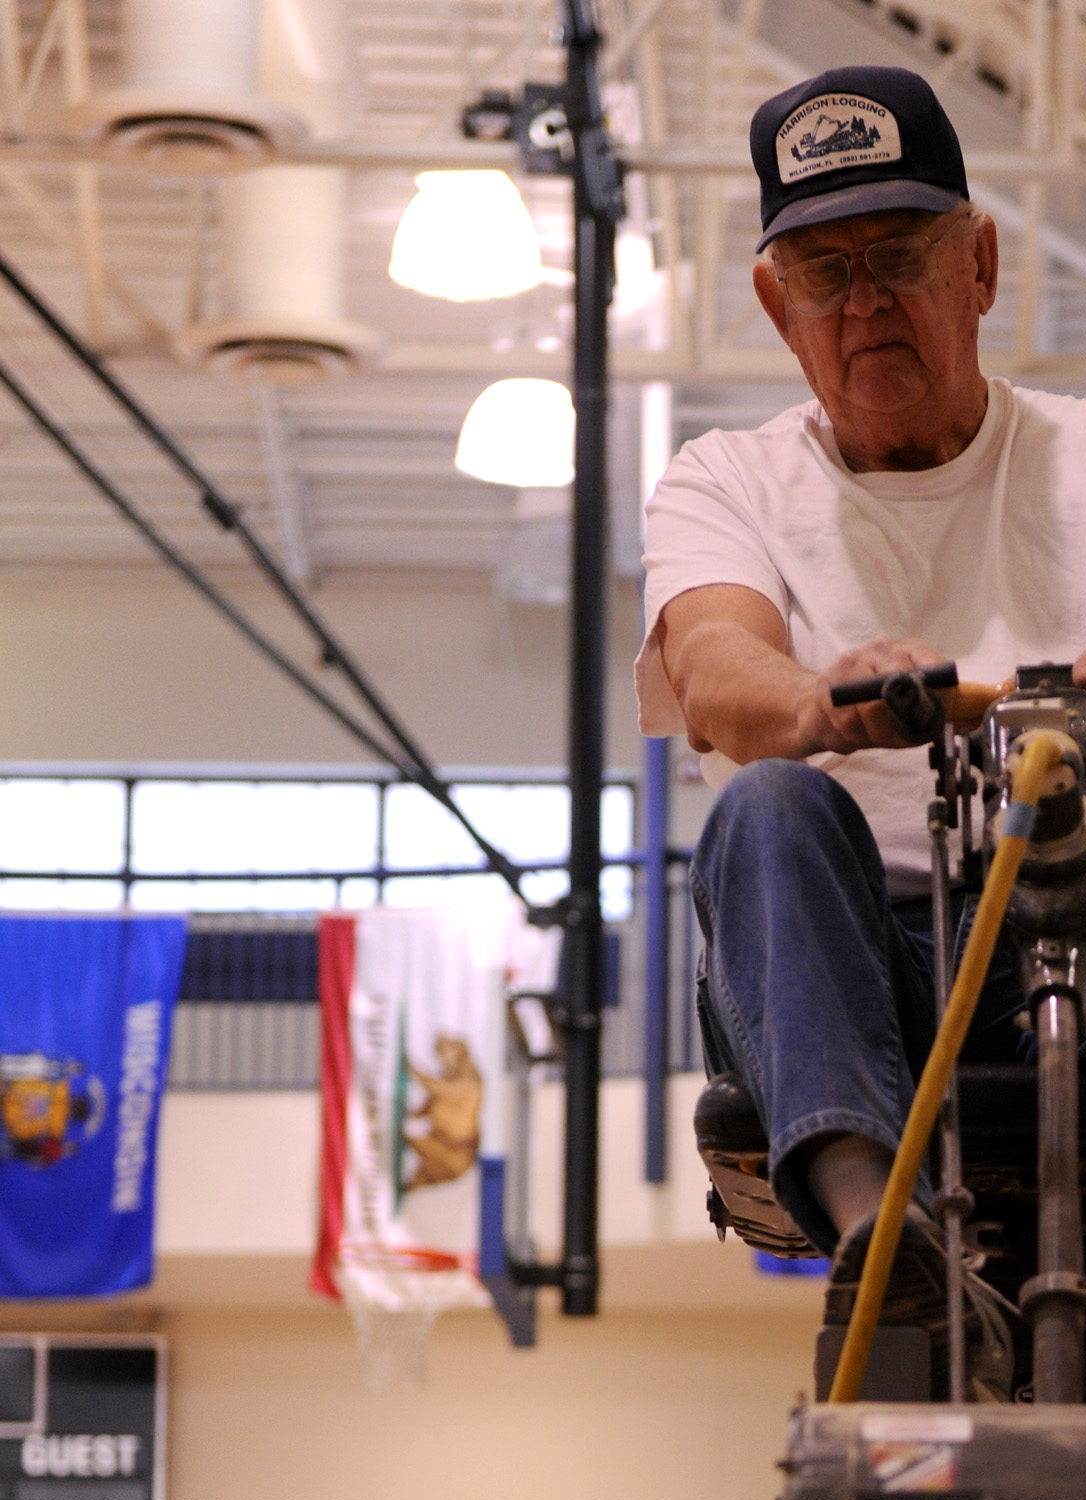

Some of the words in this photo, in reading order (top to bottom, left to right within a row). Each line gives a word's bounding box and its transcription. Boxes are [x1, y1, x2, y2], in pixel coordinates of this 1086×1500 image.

[779, 98, 830, 139] HARRISON
[832, 97, 887, 119] LOGGING
[788, 163, 825, 178] WILLISTON,
[111, 1000, 163, 1214] WISCONSIN
[21, 1432, 141, 1478] GUEST
